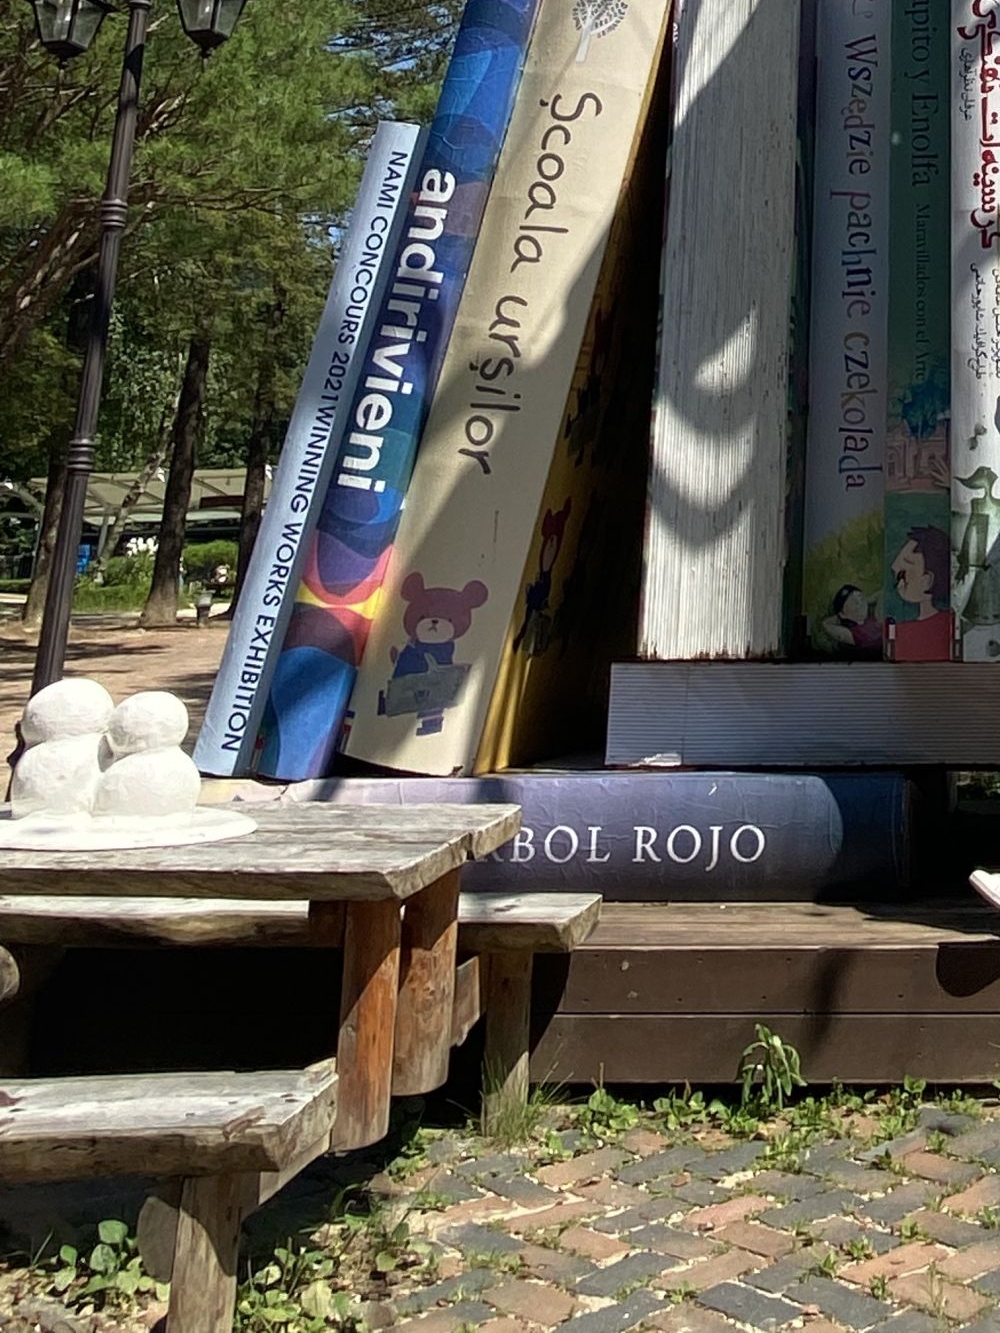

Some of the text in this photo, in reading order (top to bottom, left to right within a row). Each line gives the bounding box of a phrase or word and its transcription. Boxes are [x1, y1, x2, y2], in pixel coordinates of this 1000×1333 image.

[903, 68, 930, 84] y
[377, 149, 409, 209] NAMI
[911, 93, 939, 186] Enolfa
[338, 216, 388, 346] CONCOURS
[829, 34, 883, 492] Wszędzie pachnie czekolada
[337, 168, 456, 494] andirivieni
[262, 521, 304, 608] WORKS
[221, 613, 277, 752] EXHIBITION
[631, 824, 766, 872] ROJO
